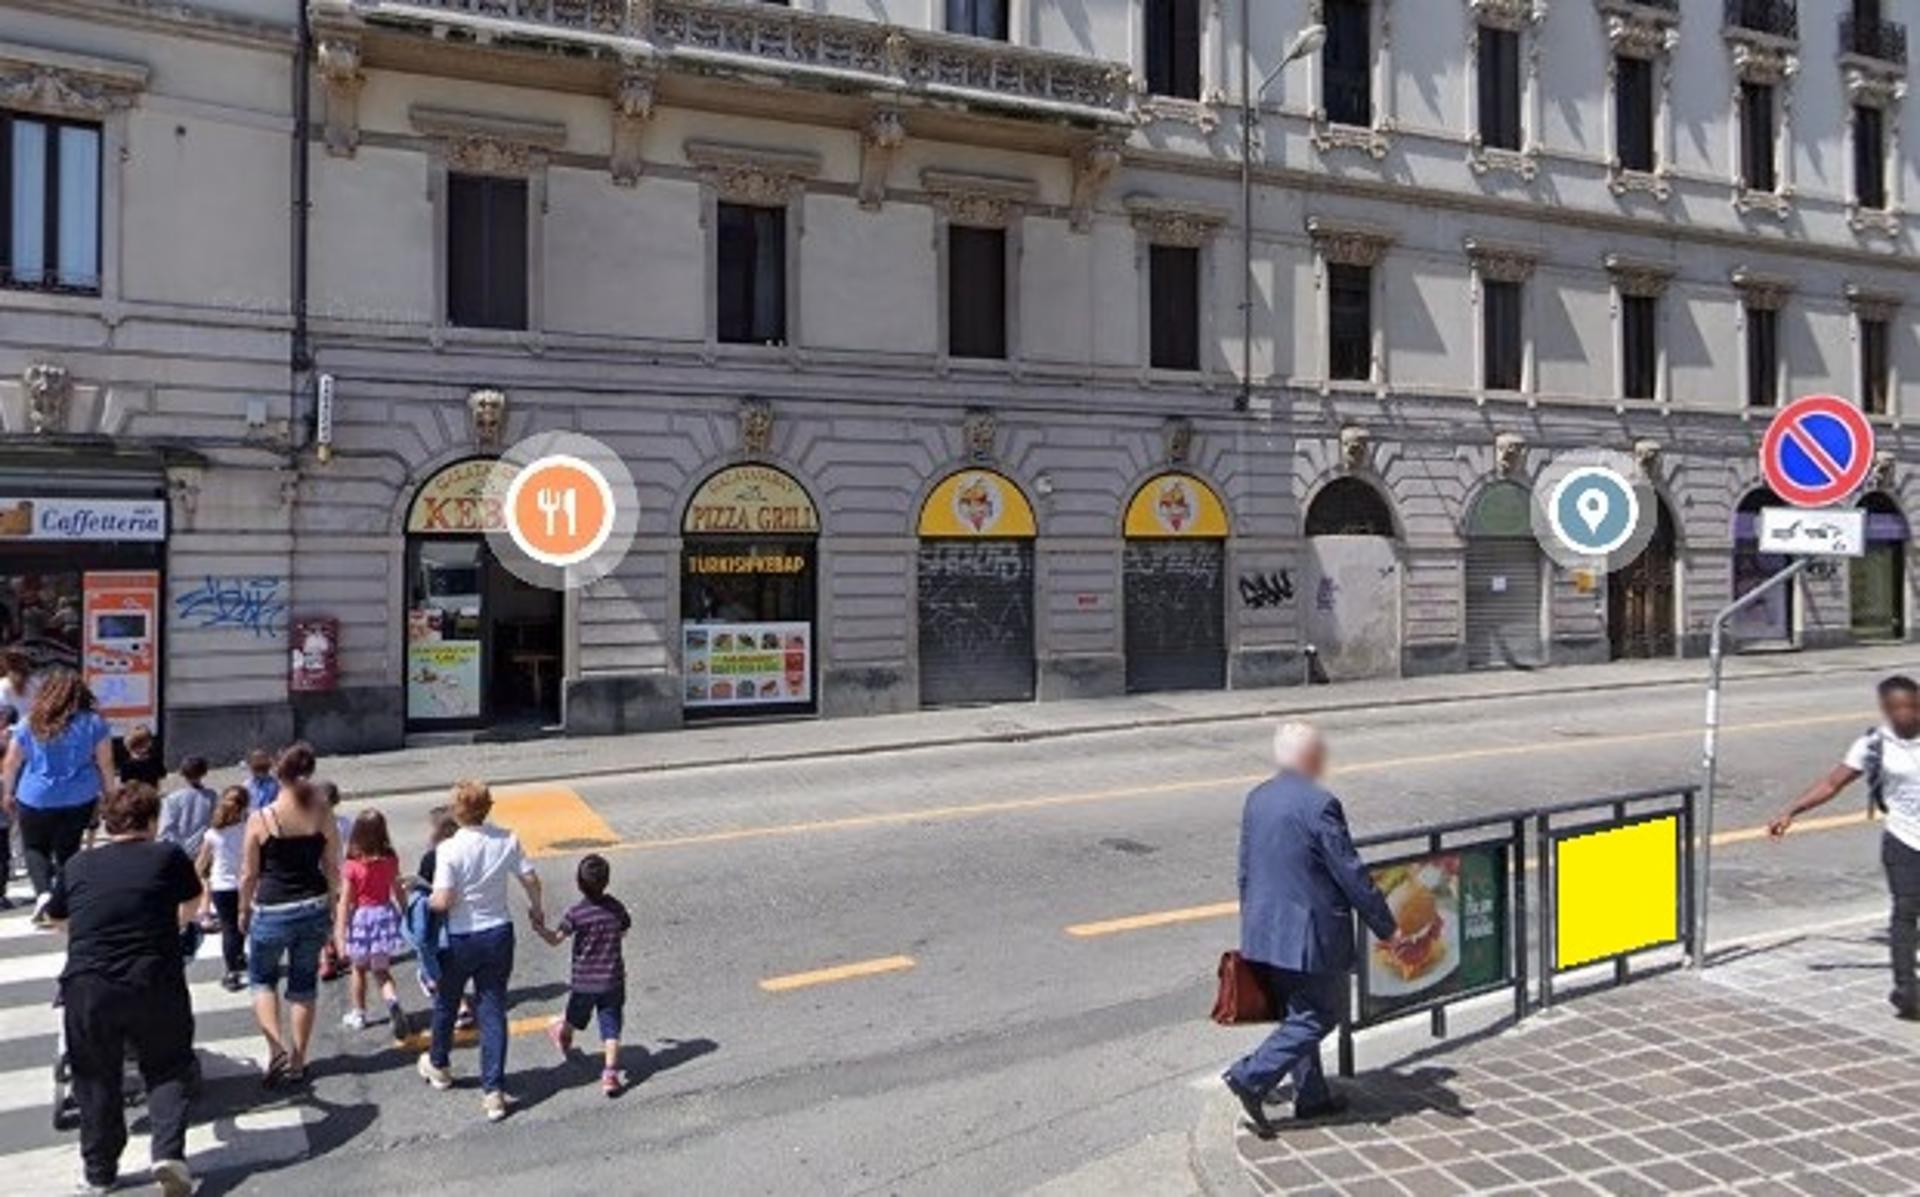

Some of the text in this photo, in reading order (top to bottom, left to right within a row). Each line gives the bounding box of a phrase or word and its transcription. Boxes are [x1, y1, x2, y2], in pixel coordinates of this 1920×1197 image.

[41, 509, 158, 534] Caffetteria
[424, 498, 510, 529] KEB
[693, 505, 813, 530] PIZZA GRILL
